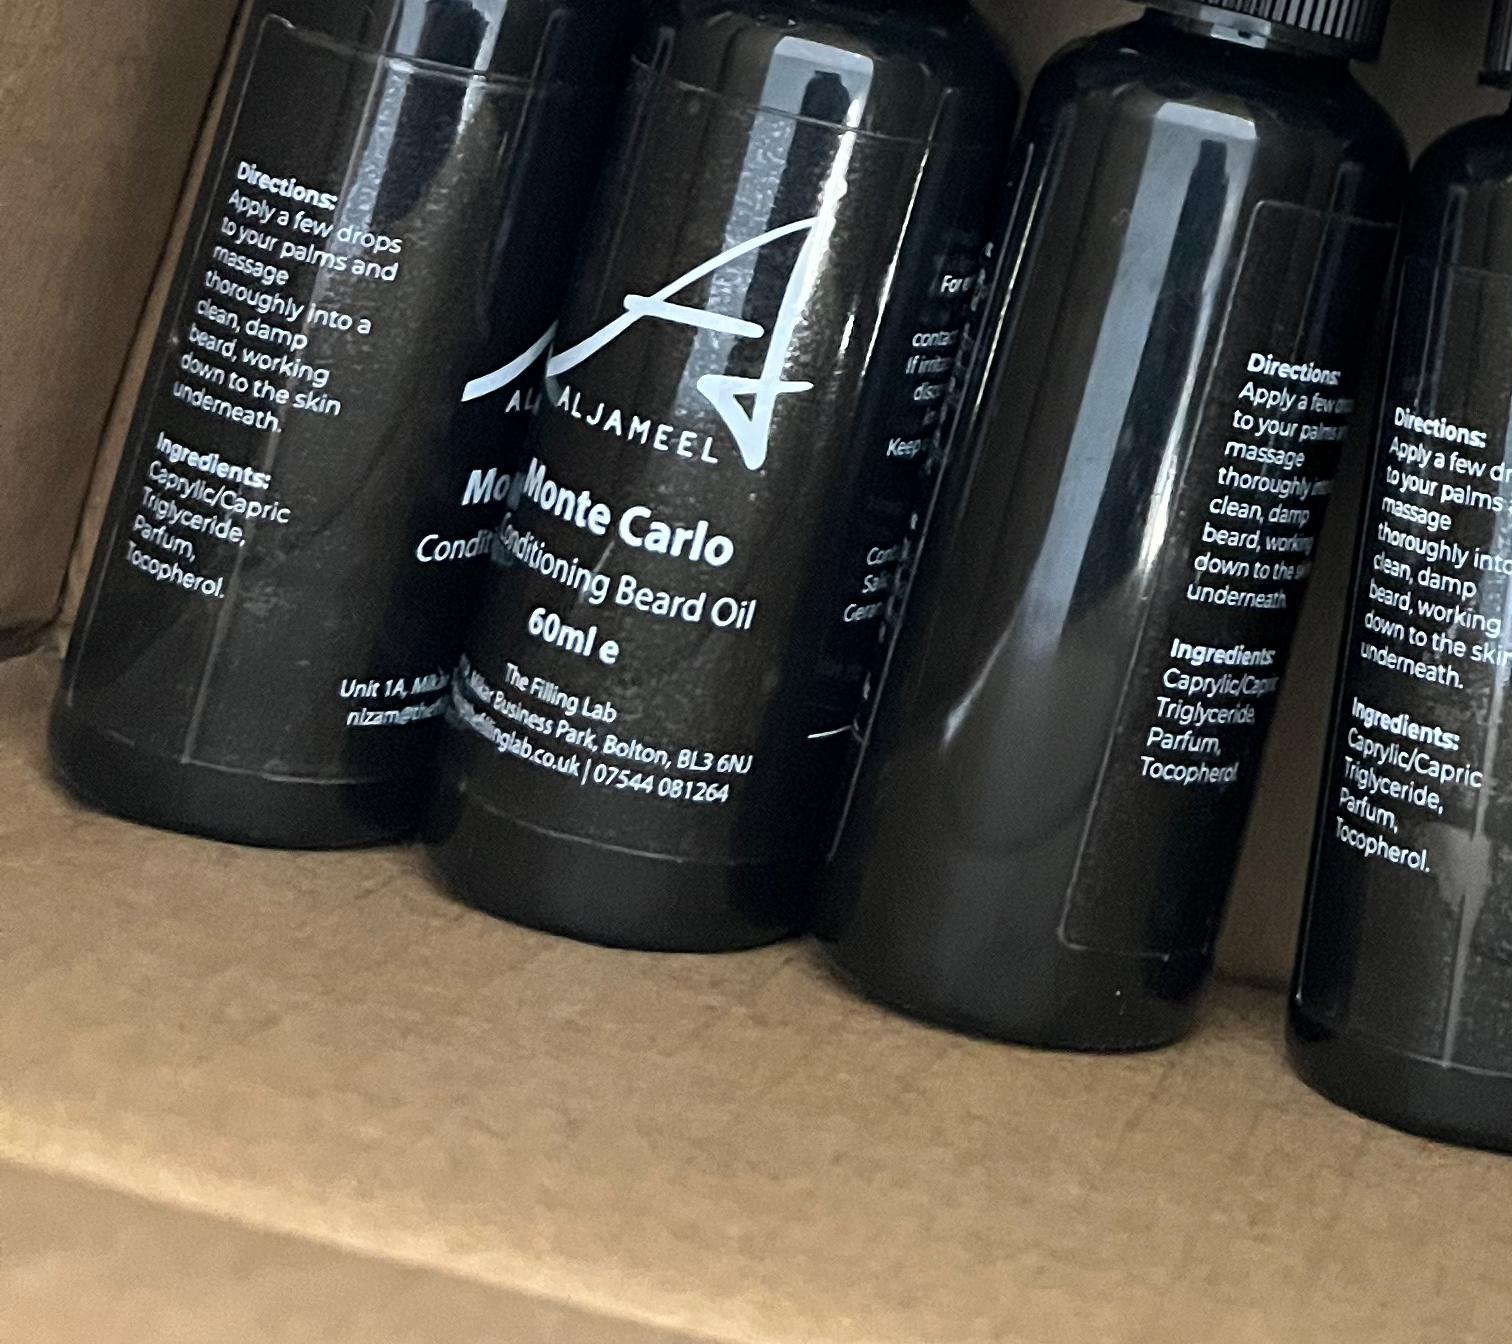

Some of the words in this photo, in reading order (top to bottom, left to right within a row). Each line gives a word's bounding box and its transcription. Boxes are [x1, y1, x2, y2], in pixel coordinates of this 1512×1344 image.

[237, 160, 337, 211] Directions:
[228, 189, 276, 227] Apply
[276, 211, 288, 226] a
[293, 210, 333, 240] few
[338, 223, 401, 255] drops
[213, 245, 288, 288] massage
[221, 218, 238, 236] to
[237, 224, 277, 258] your
[280, 238, 346, 274] palms
[351, 253, 398, 282] and
[172, 381, 282, 434] underneath.
[557, 386, 718, 463] ALJAMEEL
[1394, 407, 1487, 449] Directions:
[156, 432, 271, 490] Ingredients:
[1224, 440, 1305, 467] massage
[1388, 437, 1432, 469] Apply
[1433, 452, 1444, 469] a
[1449, 452, 1486, 477] few
[524, 457, 611, 535] Monte
[619, 506, 734, 567] Carlo
[1209, 495, 1263, 524] clean,
[1386, 465, 1400, 486] to
[1400, 473, 1438, 497] your
[1441, 483, 1503, 512] palms
[133, 514, 196, 563] Parfum,
[142, 486, 246, 547] Triglyceride,
[1381, 496, 1451, 532] massage
[126, 541, 225, 598] Tocopherol.
[1193, 552, 1249, 577] down
[1254, 558, 1271, 579] to
[1378, 522, 1469, 569] thoroughly
[1373, 551, 1414, 585] clean,
[1417, 568, 1477, 601] damp
[615, 574, 706, 622] Beard
[711, 597, 757, 629] Oil
[1369, 579, 1414, 613] beard,
[1417, 598, 1501, 639] working
[528, 607, 597, 657] 60ml
[1365, 610, 1404, 642] down
[1408, 626, 1427, 647] to
[1432, 633, 1466, 657] the
[340, 679, 377, 699] Unit
[1360, 641, 1464, 689] underneath.
[504, 663, 528, 691] The
[530, 677, 578, 716] Filling
[582, 698, 617, 723] Lab
[493, 691, 553, 735] Business
[555, 720, 598, 753] Park,
[603, 735, 672, 770] Bolton,
[677, 750, 712, 772] BL3
[717, 754, 753, 775] 6NJ
[1146, 727, 1222, 755] Parfum,
[1351, 697, 1460, 751] Ingredients:
[1347, 727, 1483, 788] Caprylic/Capric
[594, 763, 654, 793] 07544
[658, 778, 729, 803] 081264
[1344, 758, 1444, 815] Triglyceride,
[1339, 787, 1400, 833] Parfum,
[1335, 817, 1432, 875] Tocopherol.
